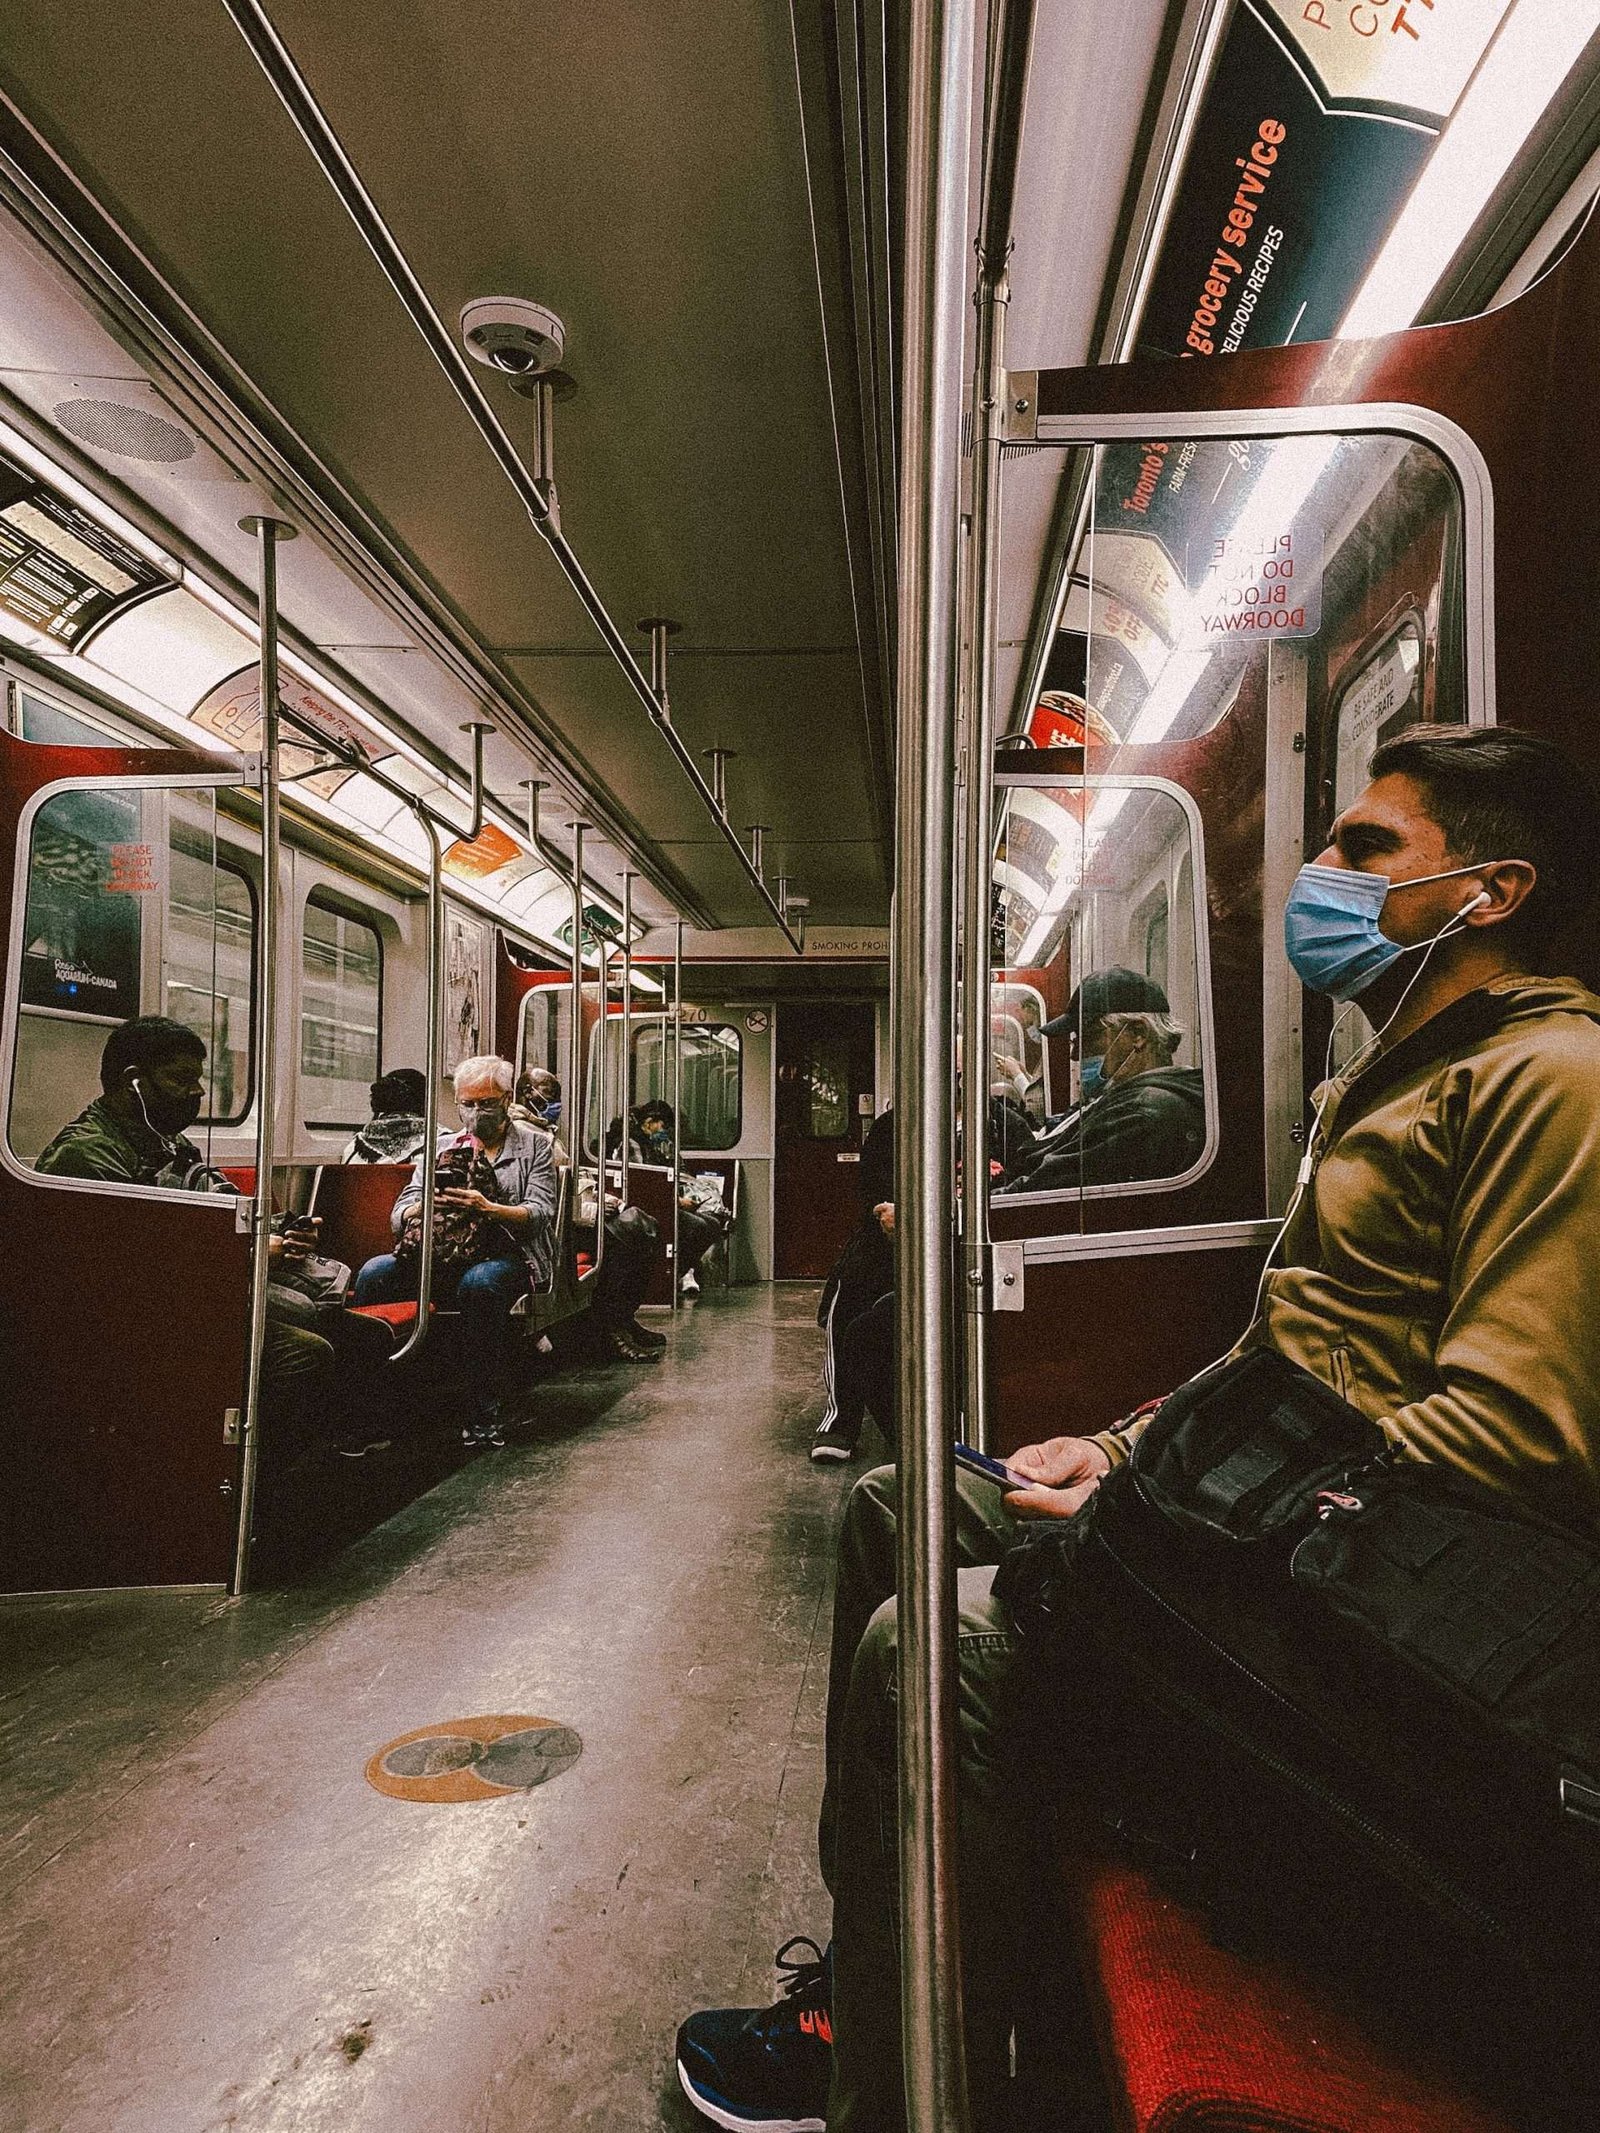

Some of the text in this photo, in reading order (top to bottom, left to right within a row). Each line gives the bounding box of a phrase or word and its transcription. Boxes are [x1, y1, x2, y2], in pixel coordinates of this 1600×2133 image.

[1186, 118, 1287, 355] grocery service
[1246, 225, 1285, 293] RECIPES
[1122, 442, 1169, 514] Toronto's
[1151, 573, 1169, 599] TTC
[1123, 614, 1143, 641] OFF
[811, 941, 859, 951] SMOKING
